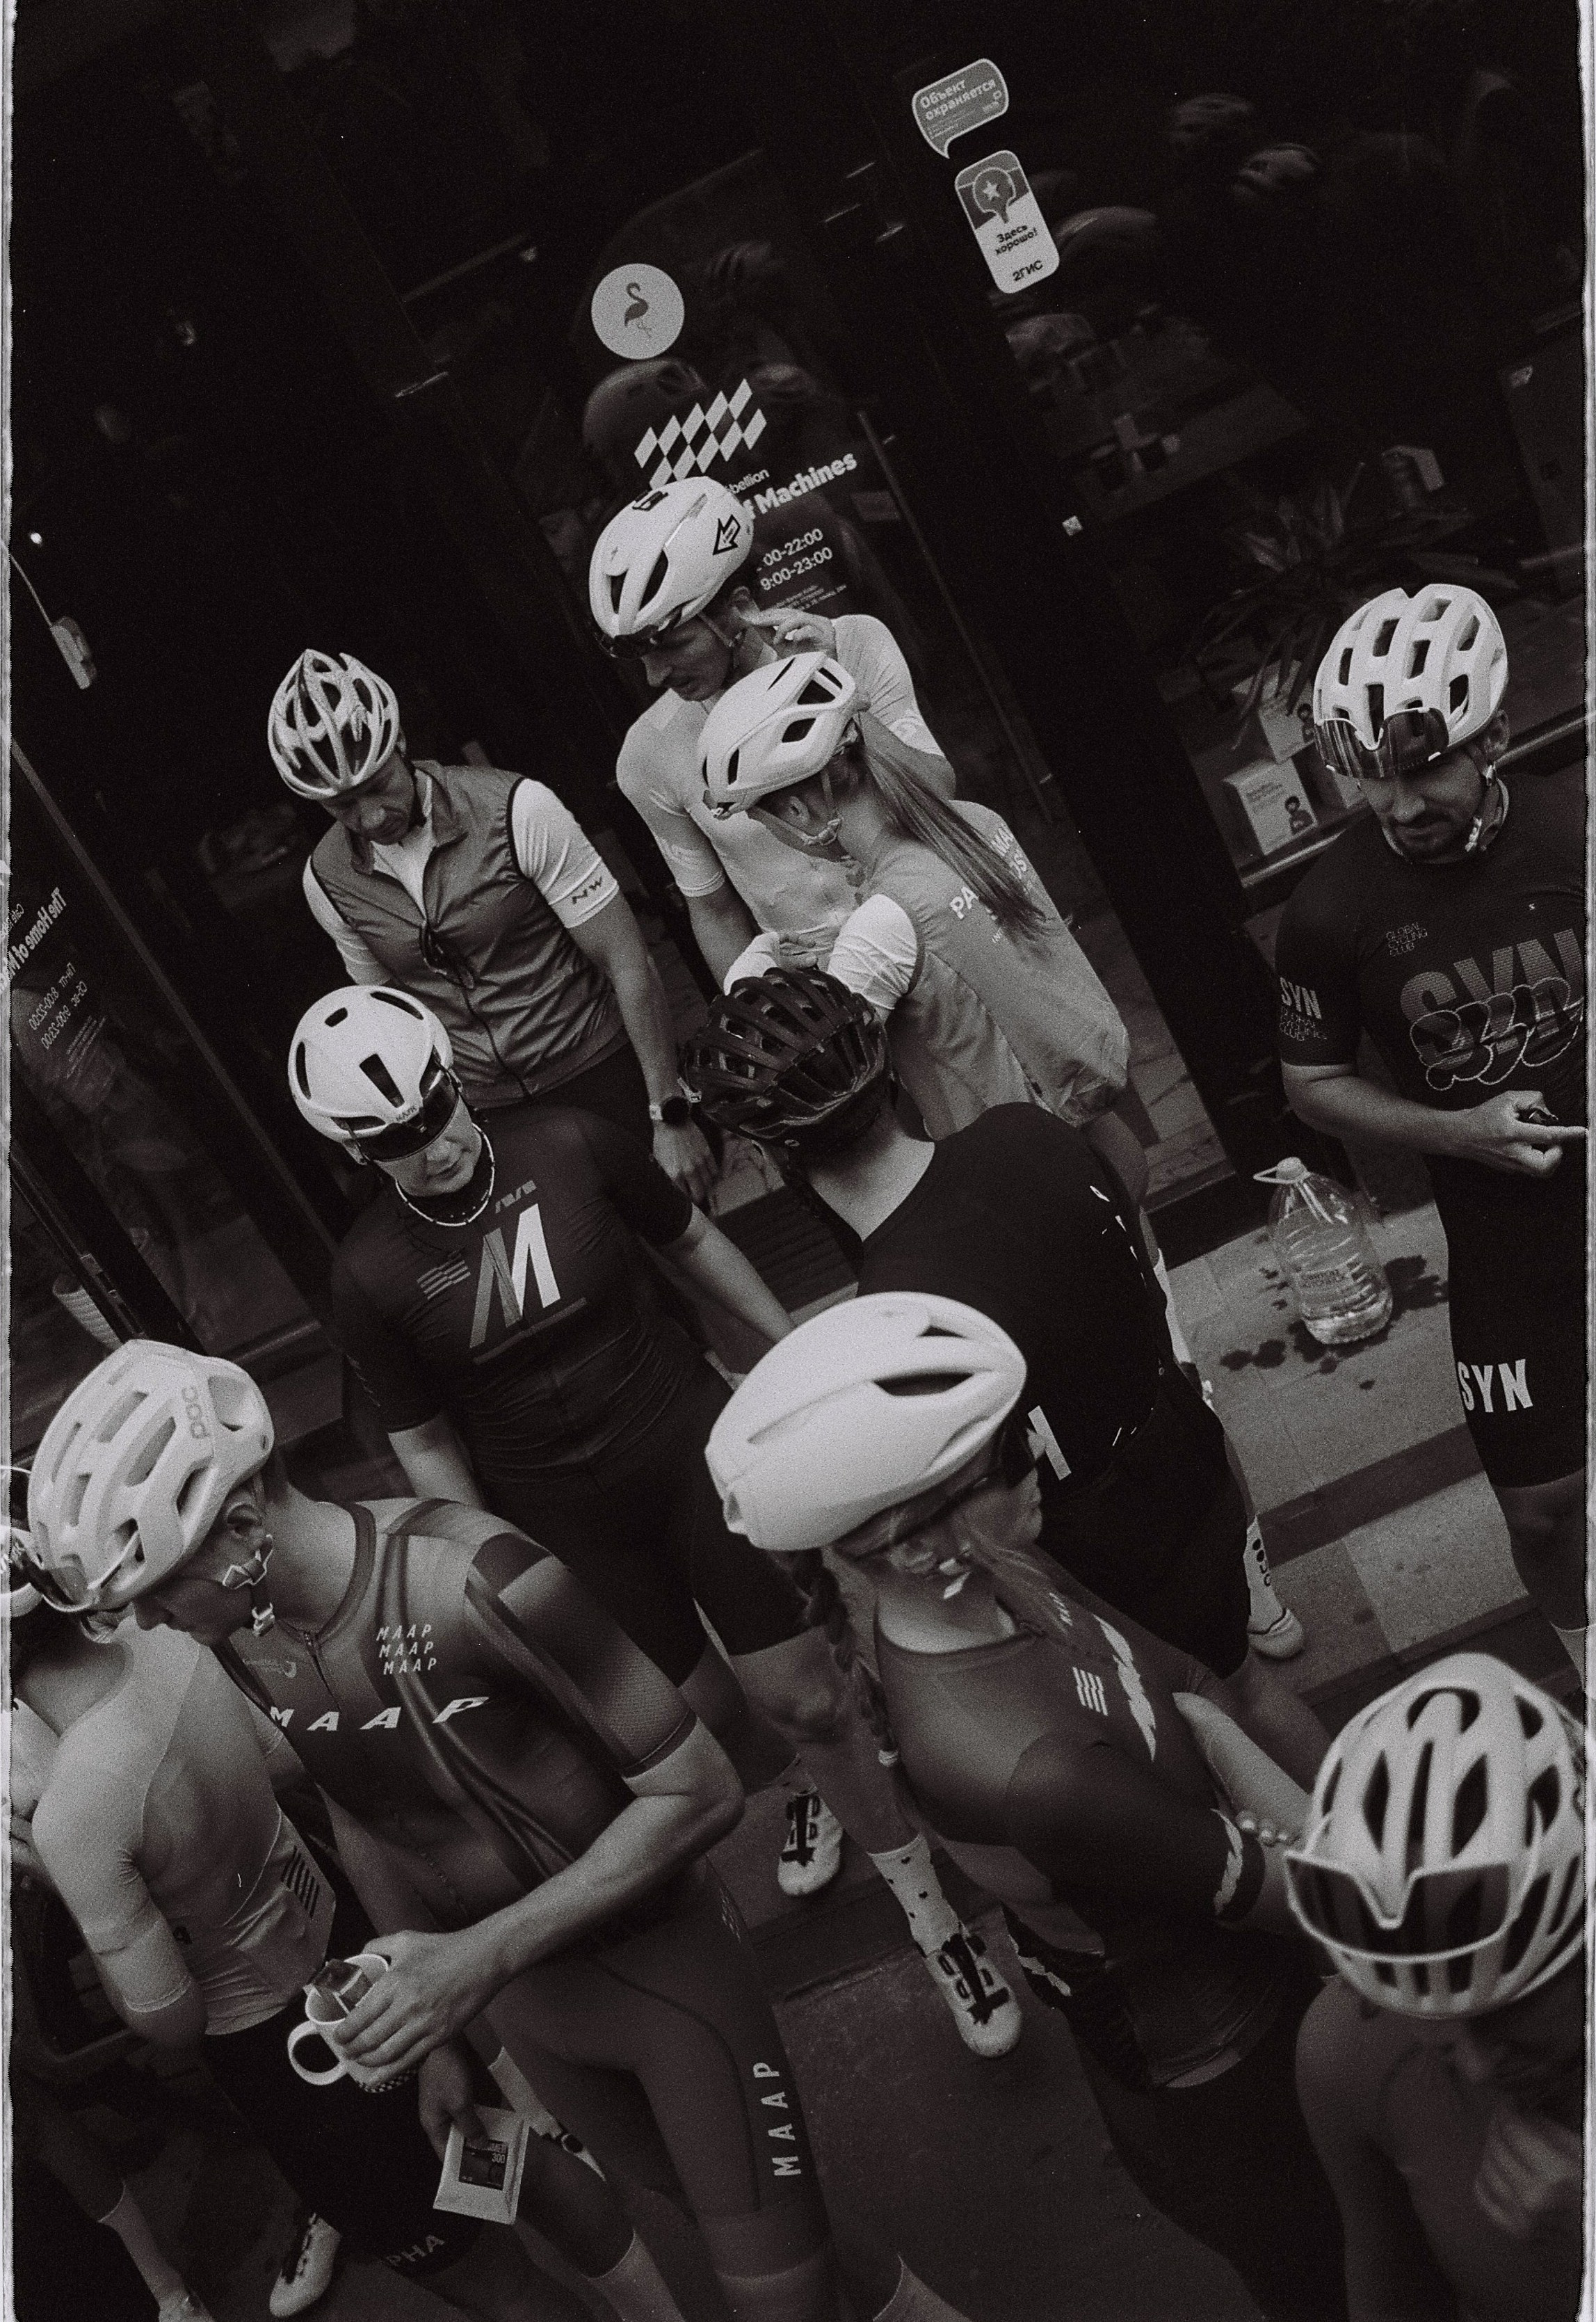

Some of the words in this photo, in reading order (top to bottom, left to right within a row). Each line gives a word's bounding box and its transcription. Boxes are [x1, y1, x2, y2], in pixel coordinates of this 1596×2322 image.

[920, 80, 965, 109] Объект
[926, 79, 996, 120] охраняется
[995, 227, 1038, 255] хорошо!
[997, 225, 1027, 243] Здесь
[1013, 260, 1043, 281] 2ГИС
[727, 469, 770, 494] bellion
[754, 453, 857, 514] Machines
[757, 529, 823, 572] 00-22:00
[760, 547, 832, 591] 9:00-23:00
[950, 886, 979, 919] PA
[1280, 977, 1322, 1020] SYN
[1458, 1359, 1533, 1413] SYN
[376, 1624, 431, 1641] MAAP
[379, 1642, 434, 1658] MAAP
[383, 1658, 437, 1675] MAAP
[270, 1697, 489, 1731] MAAP
[753, 2063, 801, 2176] MAAP
[386, 2234, 445, 2267] PHA
